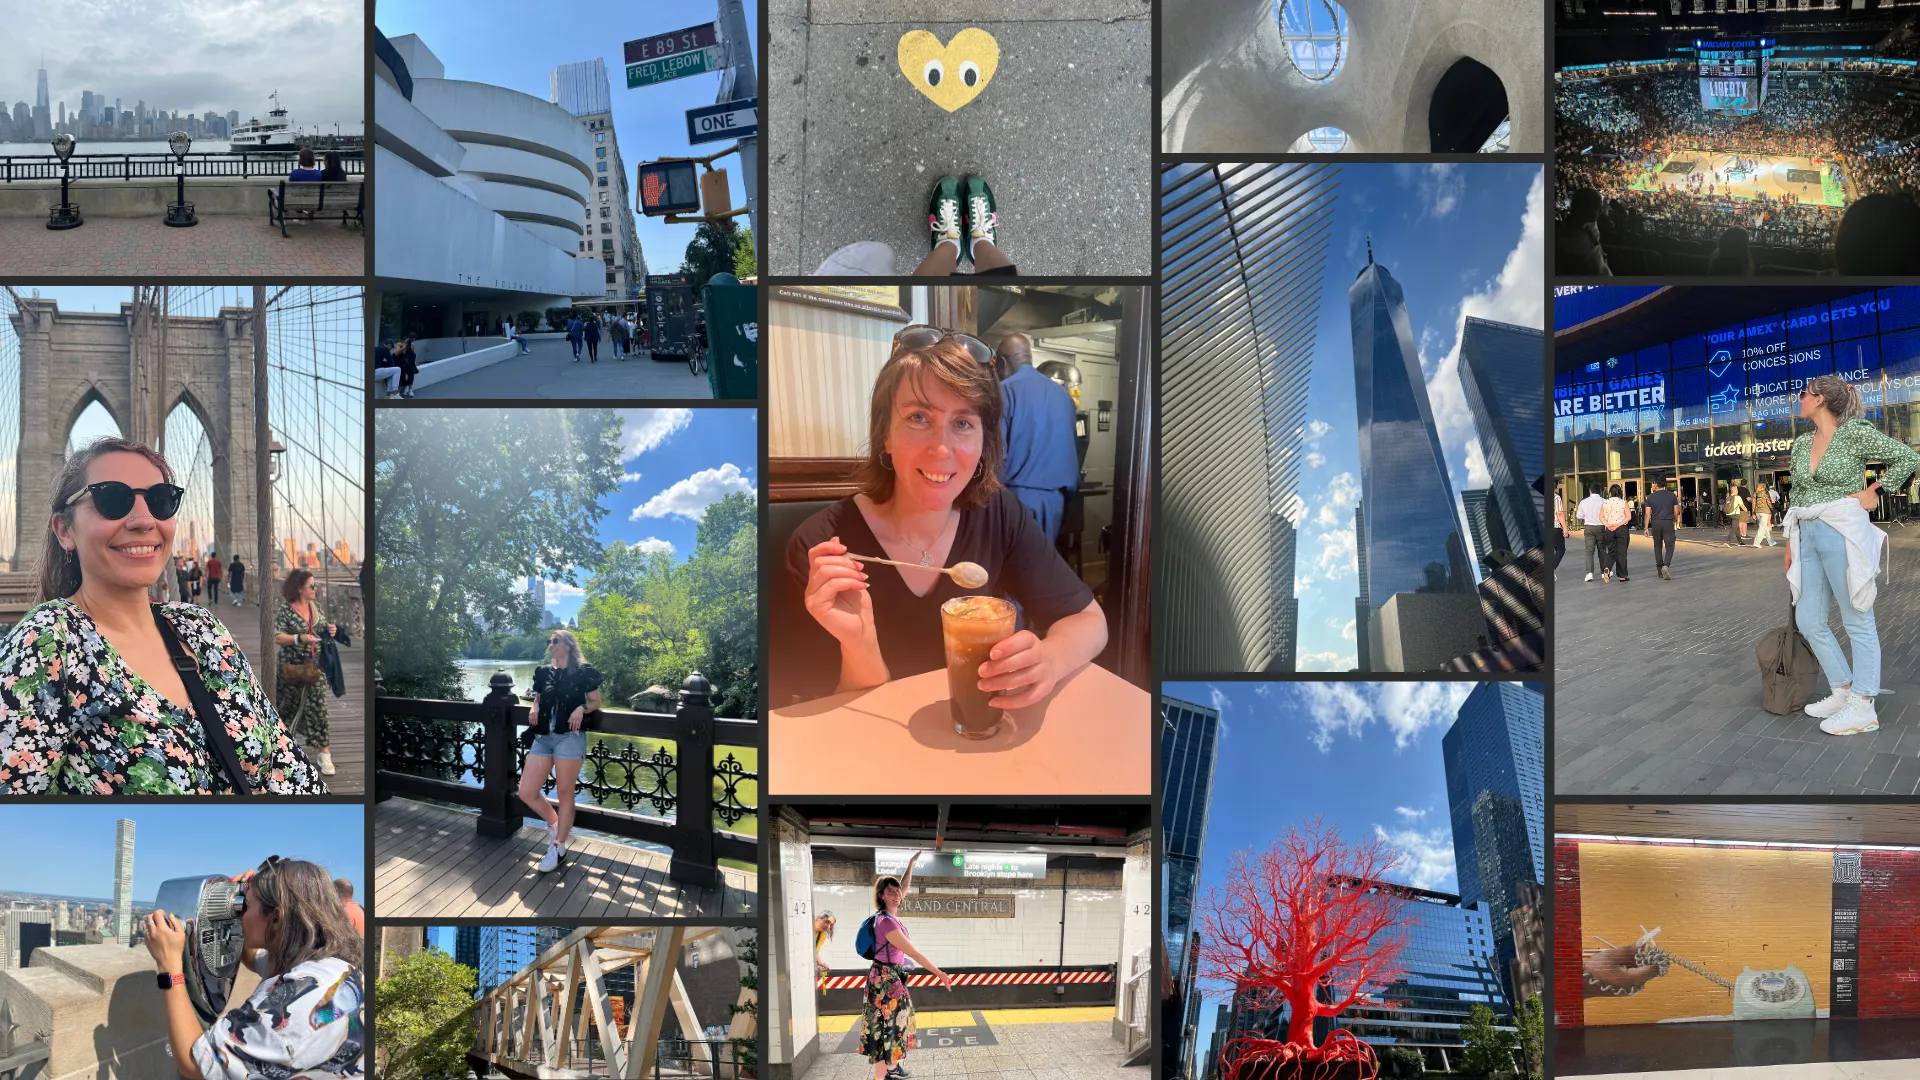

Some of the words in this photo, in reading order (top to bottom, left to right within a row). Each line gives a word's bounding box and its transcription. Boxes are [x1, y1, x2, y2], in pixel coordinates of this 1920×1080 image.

[642, 44, 649, 58] E
[656, 38, 675, 55] 89
[682, 32, 699, 49] St
[628, 63, 657, 80] FRED
[662, 52, 701, 73] LEBOW
[652, 71, 678, 82] PLACE
[1710, 81, 1747, 97] LIBERTY
[701, 112, 737, 132] ONE
[458, 273, 481, 286] THE
[1703, 330, 1736, 345] YOUR
[1781, 314, 1817, 330] CARD
[1821, 306, 1857, 323] GETS
[1860, 299, 1891, 315] YOU
[1742, 347, 1764, 359] 10%
[1766, 341, 1787, 354] OFF
[1743, 350, 1821, 372] CONCESSIONS
[1608, 372, 1664, 391] GAMES
[1744, 379, 1803, 396] DEDICATED
[1554, 398, 1584, 417] ARE
[1589, 386, 1665, 412] BETTER
[1745, 399, 1752, 409] &
[1755, 394, 1787, 408] MORE
[1751, 409, 1769, 418] BAG
[1771, 406, 1791, 416] LINE
[1679, 442, 1698, 453] GET
[1704, 438, 1794, 457] ticketmaster
[914, 861, 925, 869] Av
[981, 863, 1003, 872] nights
[963, 870, 996, 878] Brooklyn
[794, 902, 806, 915] 42
[946, 901, 1008, 913] CENTRAL
[1133, 904, 1151, 915] 42
